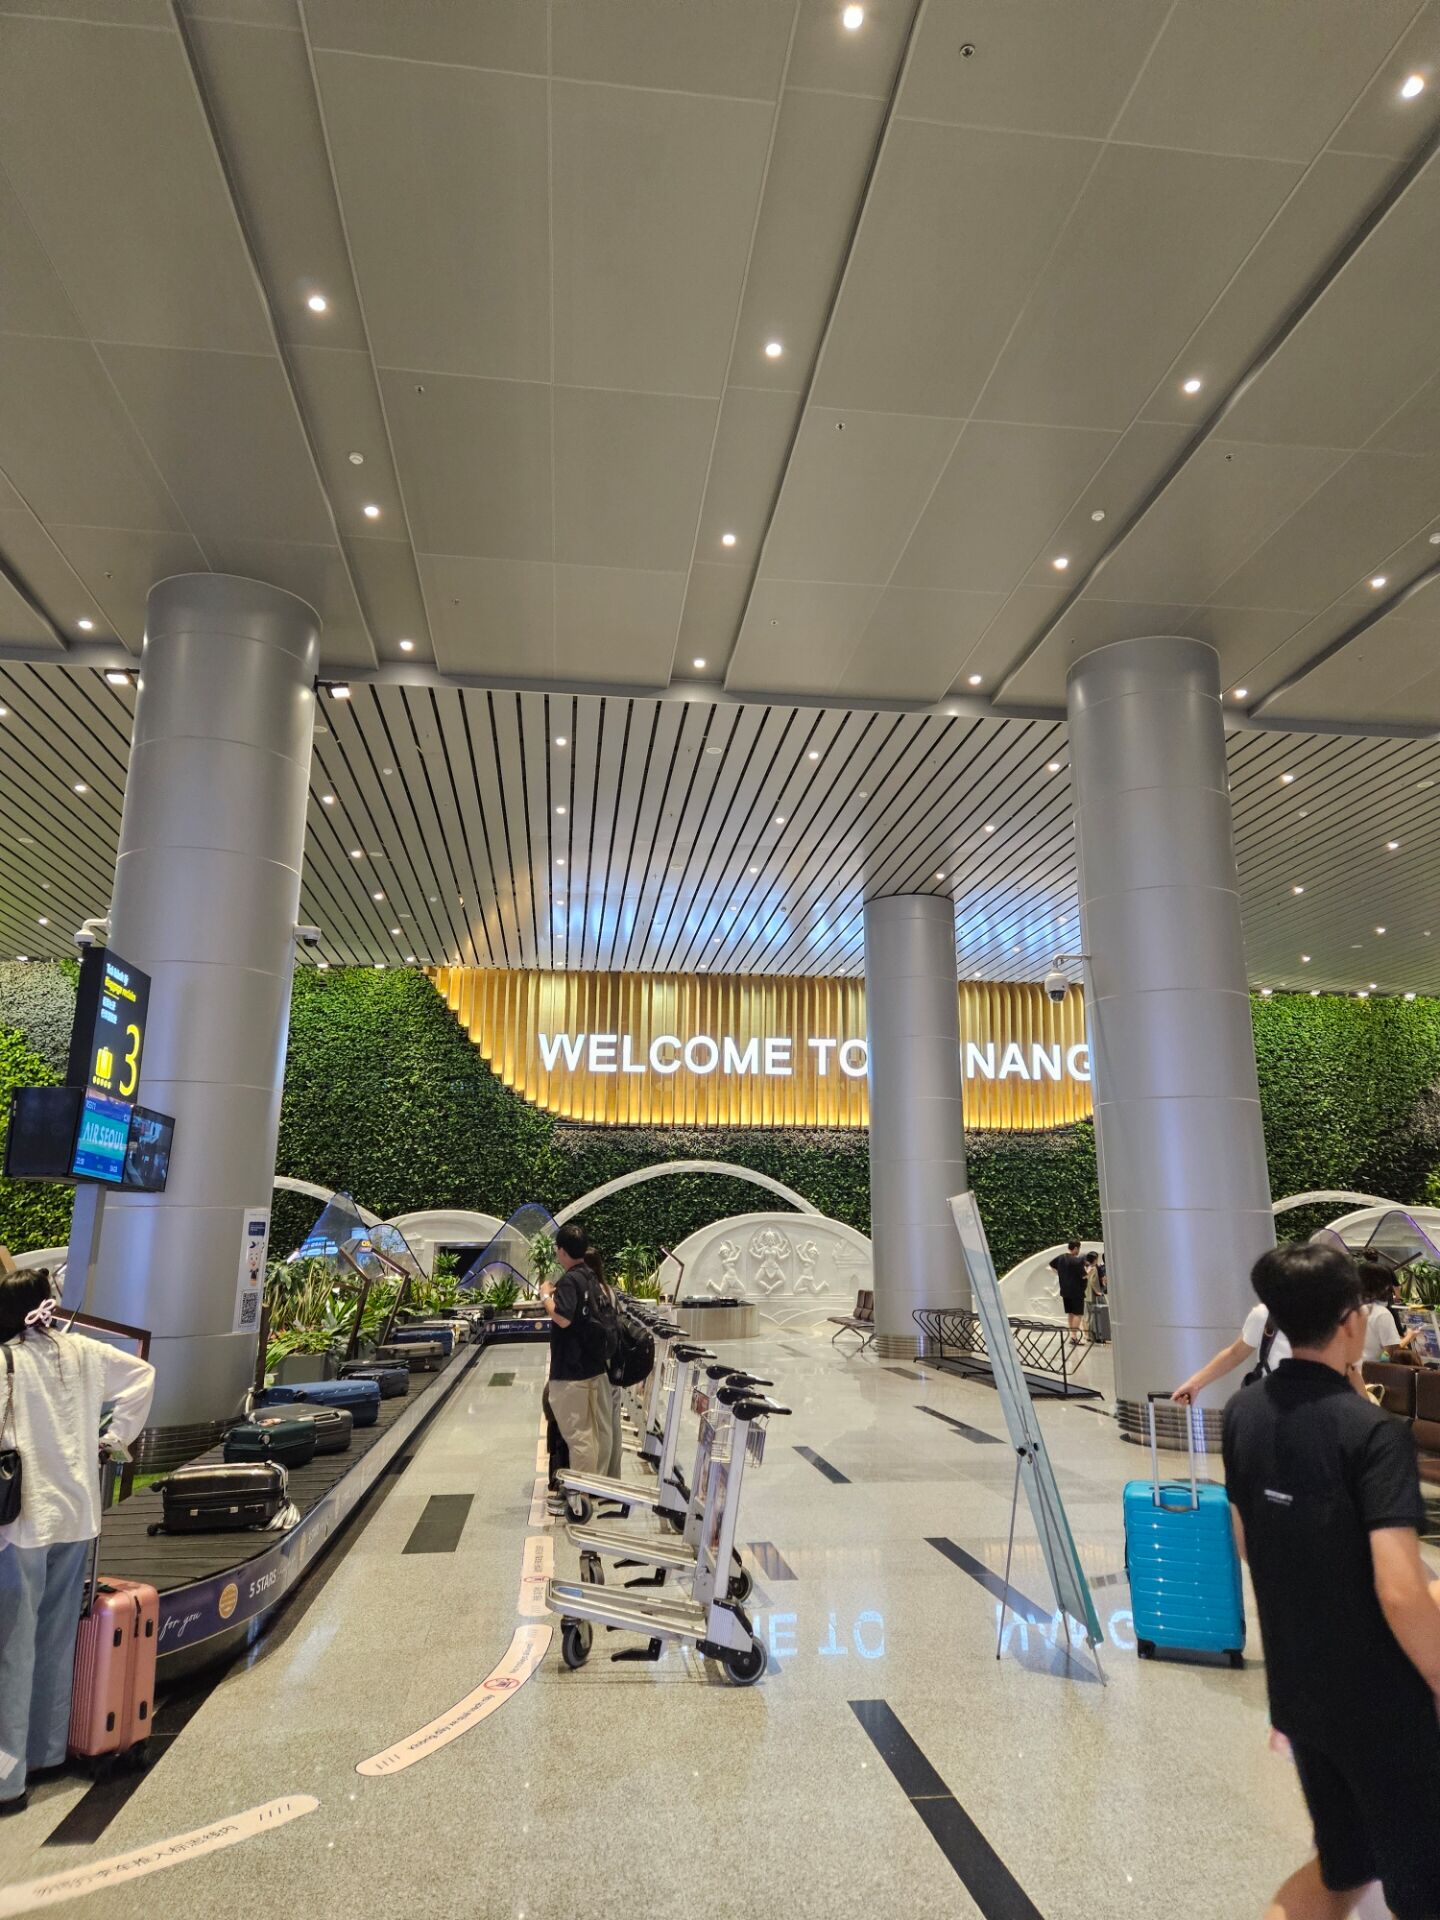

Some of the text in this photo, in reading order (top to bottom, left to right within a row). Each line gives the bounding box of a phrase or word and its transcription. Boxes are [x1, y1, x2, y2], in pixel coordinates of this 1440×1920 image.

[119, 1024, 140, 1096] 3
[538, 1033, 793, 1076] WELCOME
[807, 1038, 868, 1077] TO
[82, 1121, 124, 1151] AIR SEOUL
[249, 1569, 277, 1599] 5 STARS
[159, 1610, 202, 1641] for you
